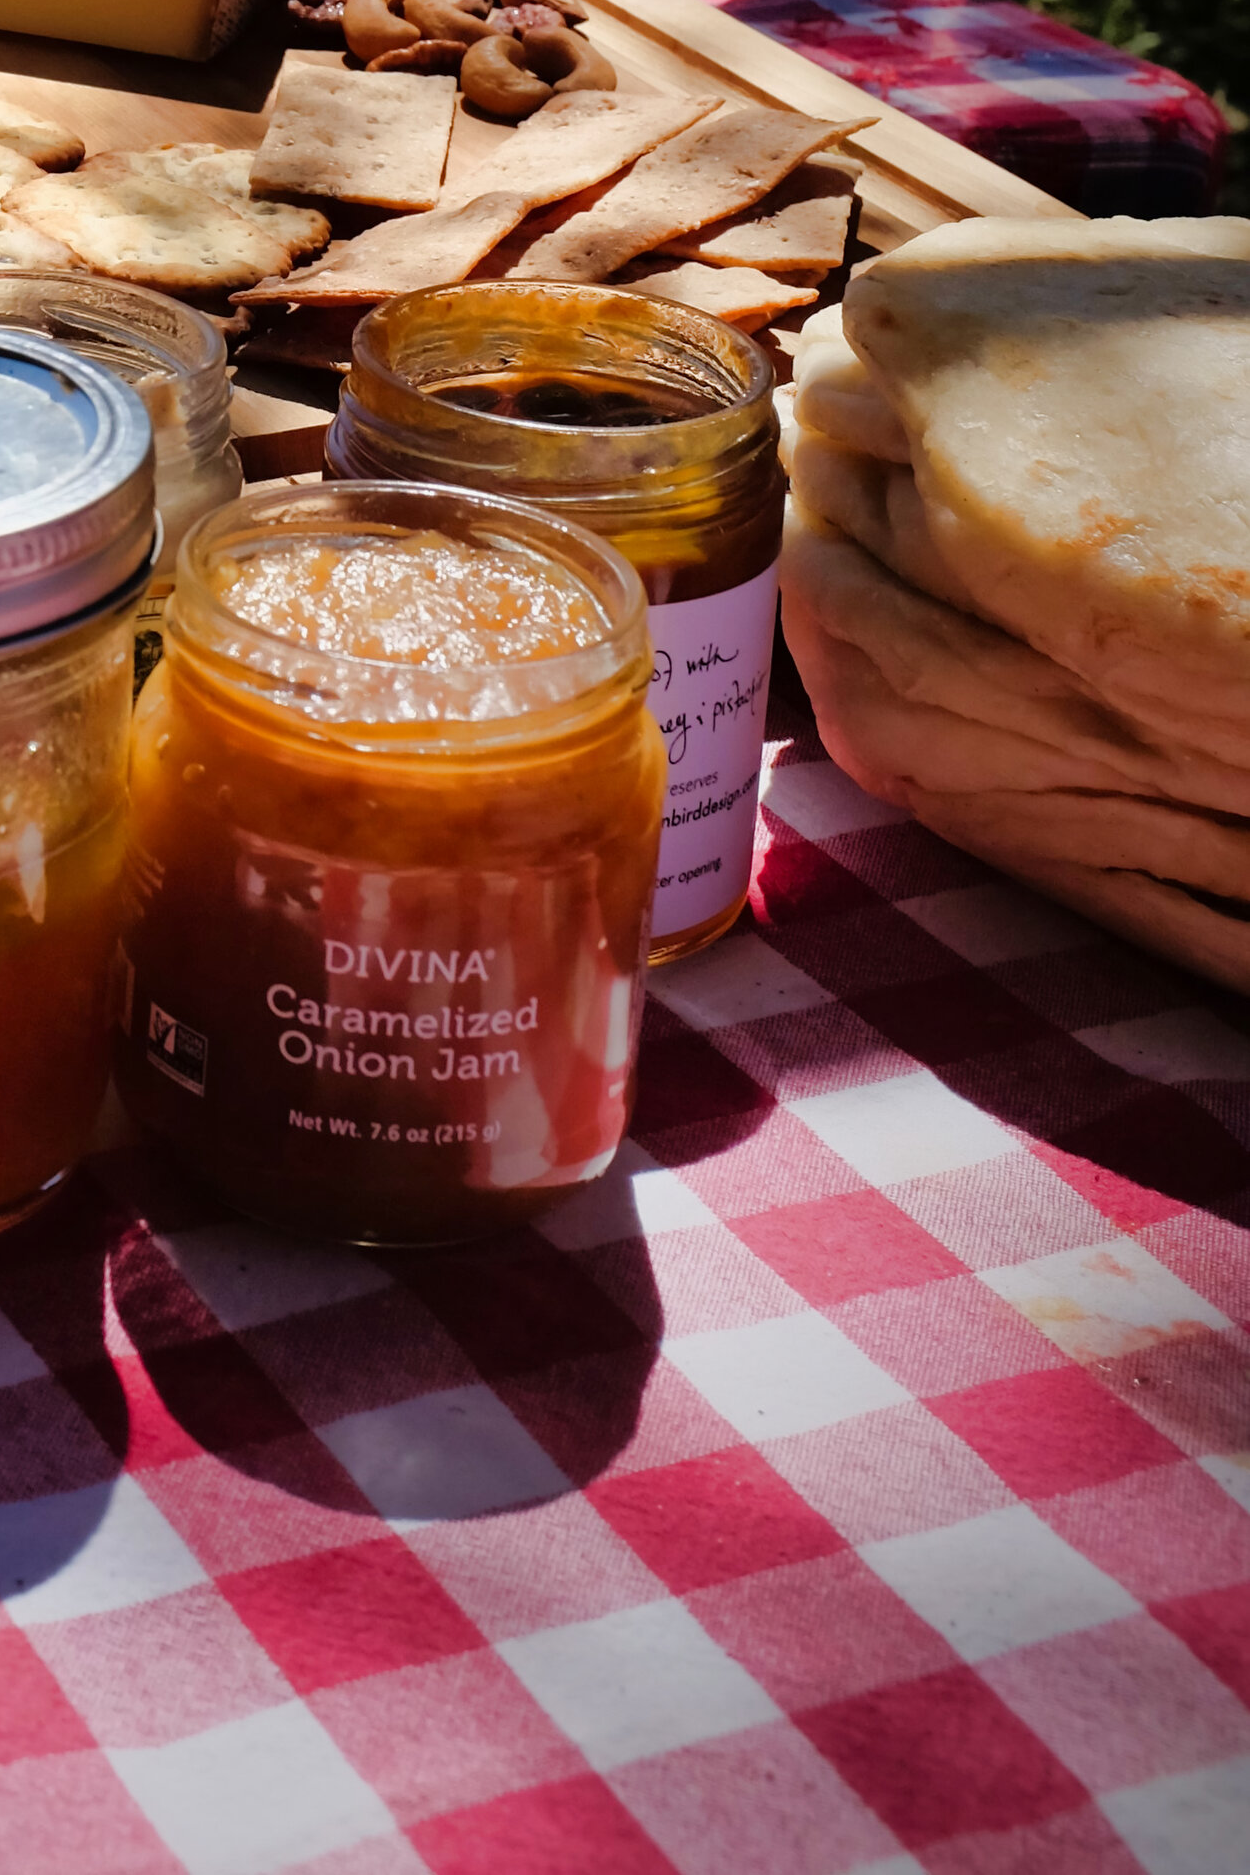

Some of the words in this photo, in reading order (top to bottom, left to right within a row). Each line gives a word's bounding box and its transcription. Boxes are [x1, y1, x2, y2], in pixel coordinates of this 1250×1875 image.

[687, 643, 739, 675] with
[266, 982, 540, 1040] Caramelized
[278, 1029, 417, 1081] Onion
[430, 1047, 521, 1081] Jam
[288, 1109, 323, 1129] Net
[328, 1117, 362, 1139] Wt.
[370, 1122, 400, 1142] 7.6
[405, 1125, 430, 1144] oz
[433, 1122, 478, 1145] (215
[481, 1120, 501, 1145] g)
